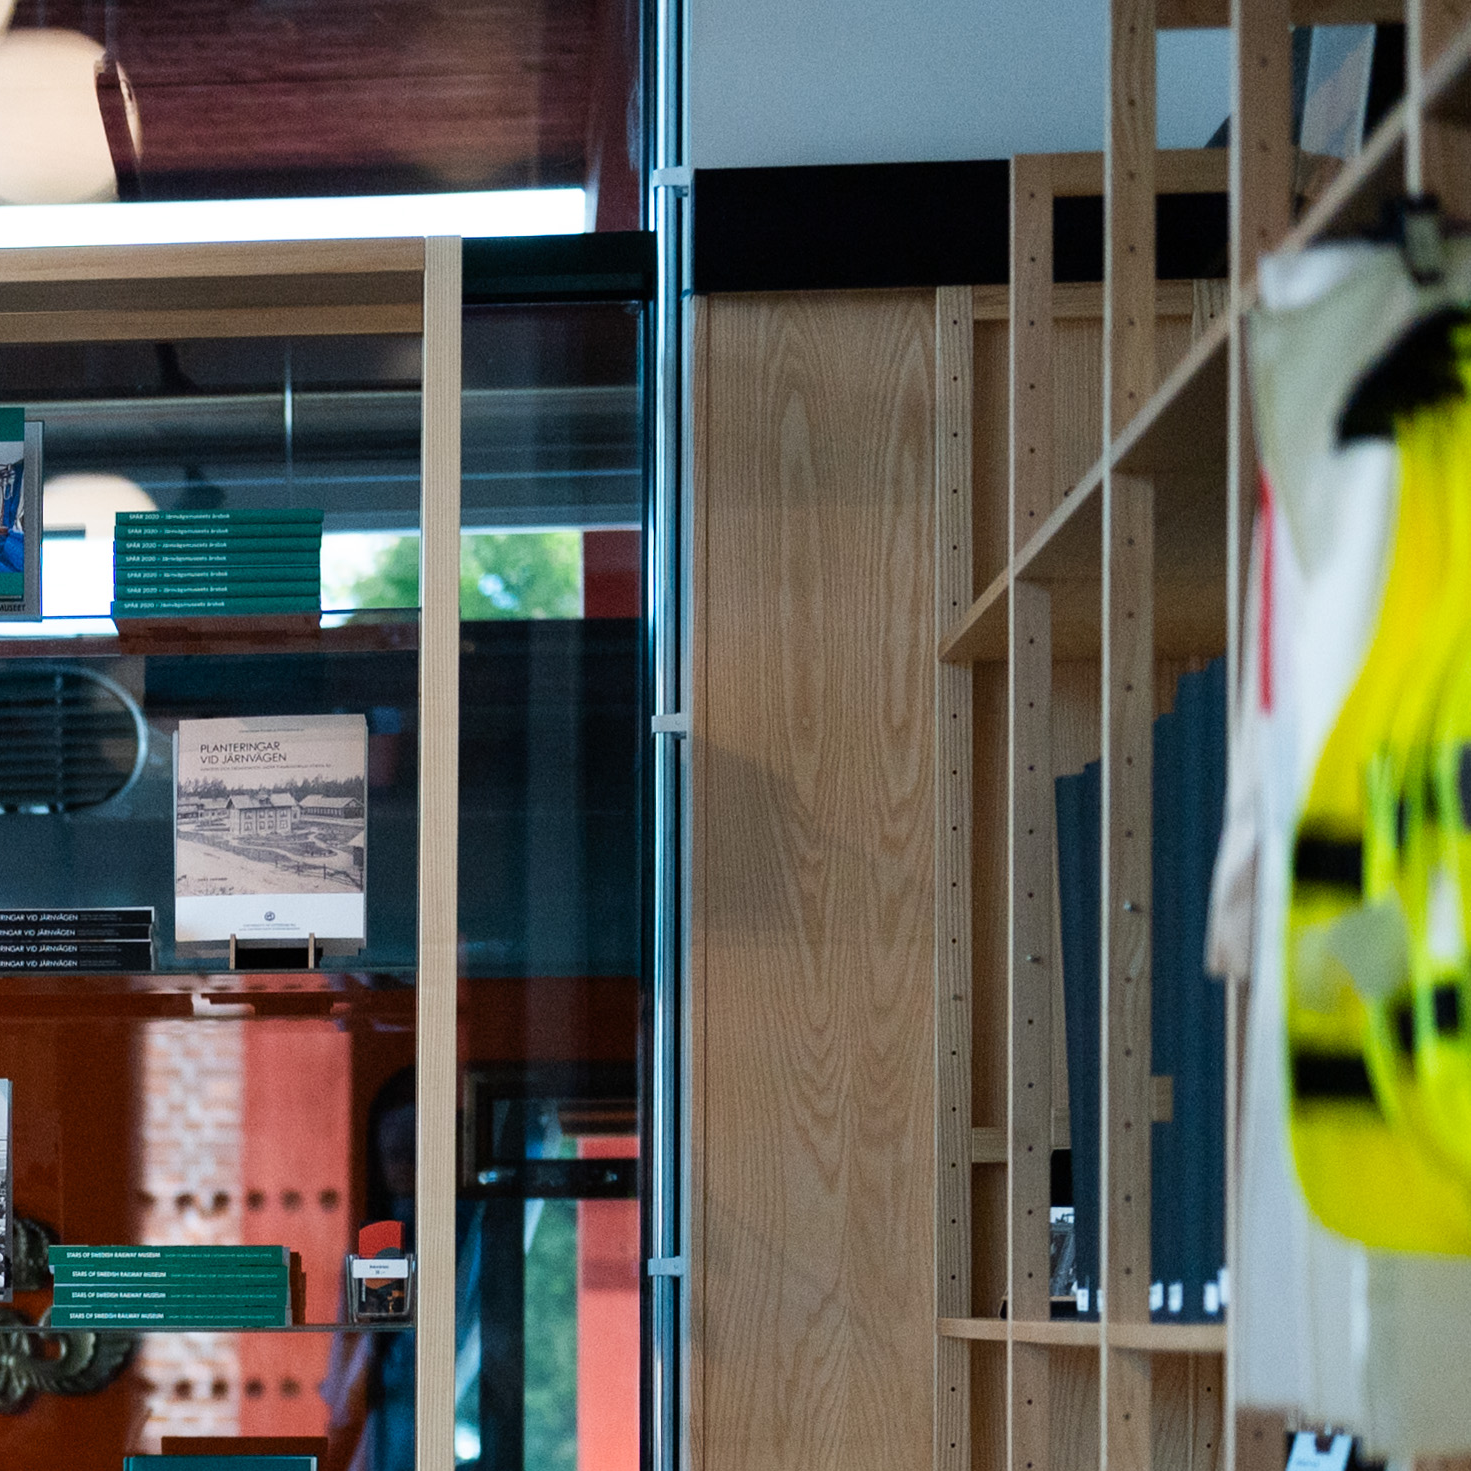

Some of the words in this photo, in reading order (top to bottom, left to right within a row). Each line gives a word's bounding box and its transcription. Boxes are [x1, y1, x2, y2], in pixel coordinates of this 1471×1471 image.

[200, 742, 280, 753] PLANTERINGAR
[200, 755, 219, 764] VID
[222, 752, 287, 763] JÄRNVÄGEN
[40, 913, 78, 921] JÄRNVÄGEN
[37, 928, 75, 936] JÄRNVÄGEN
[39, 944, 77, 952] JÄRNVÄGEN
[26, 960, 37, 968] VID
[38, 959, 77, 967] JÄRNVÄGEN
